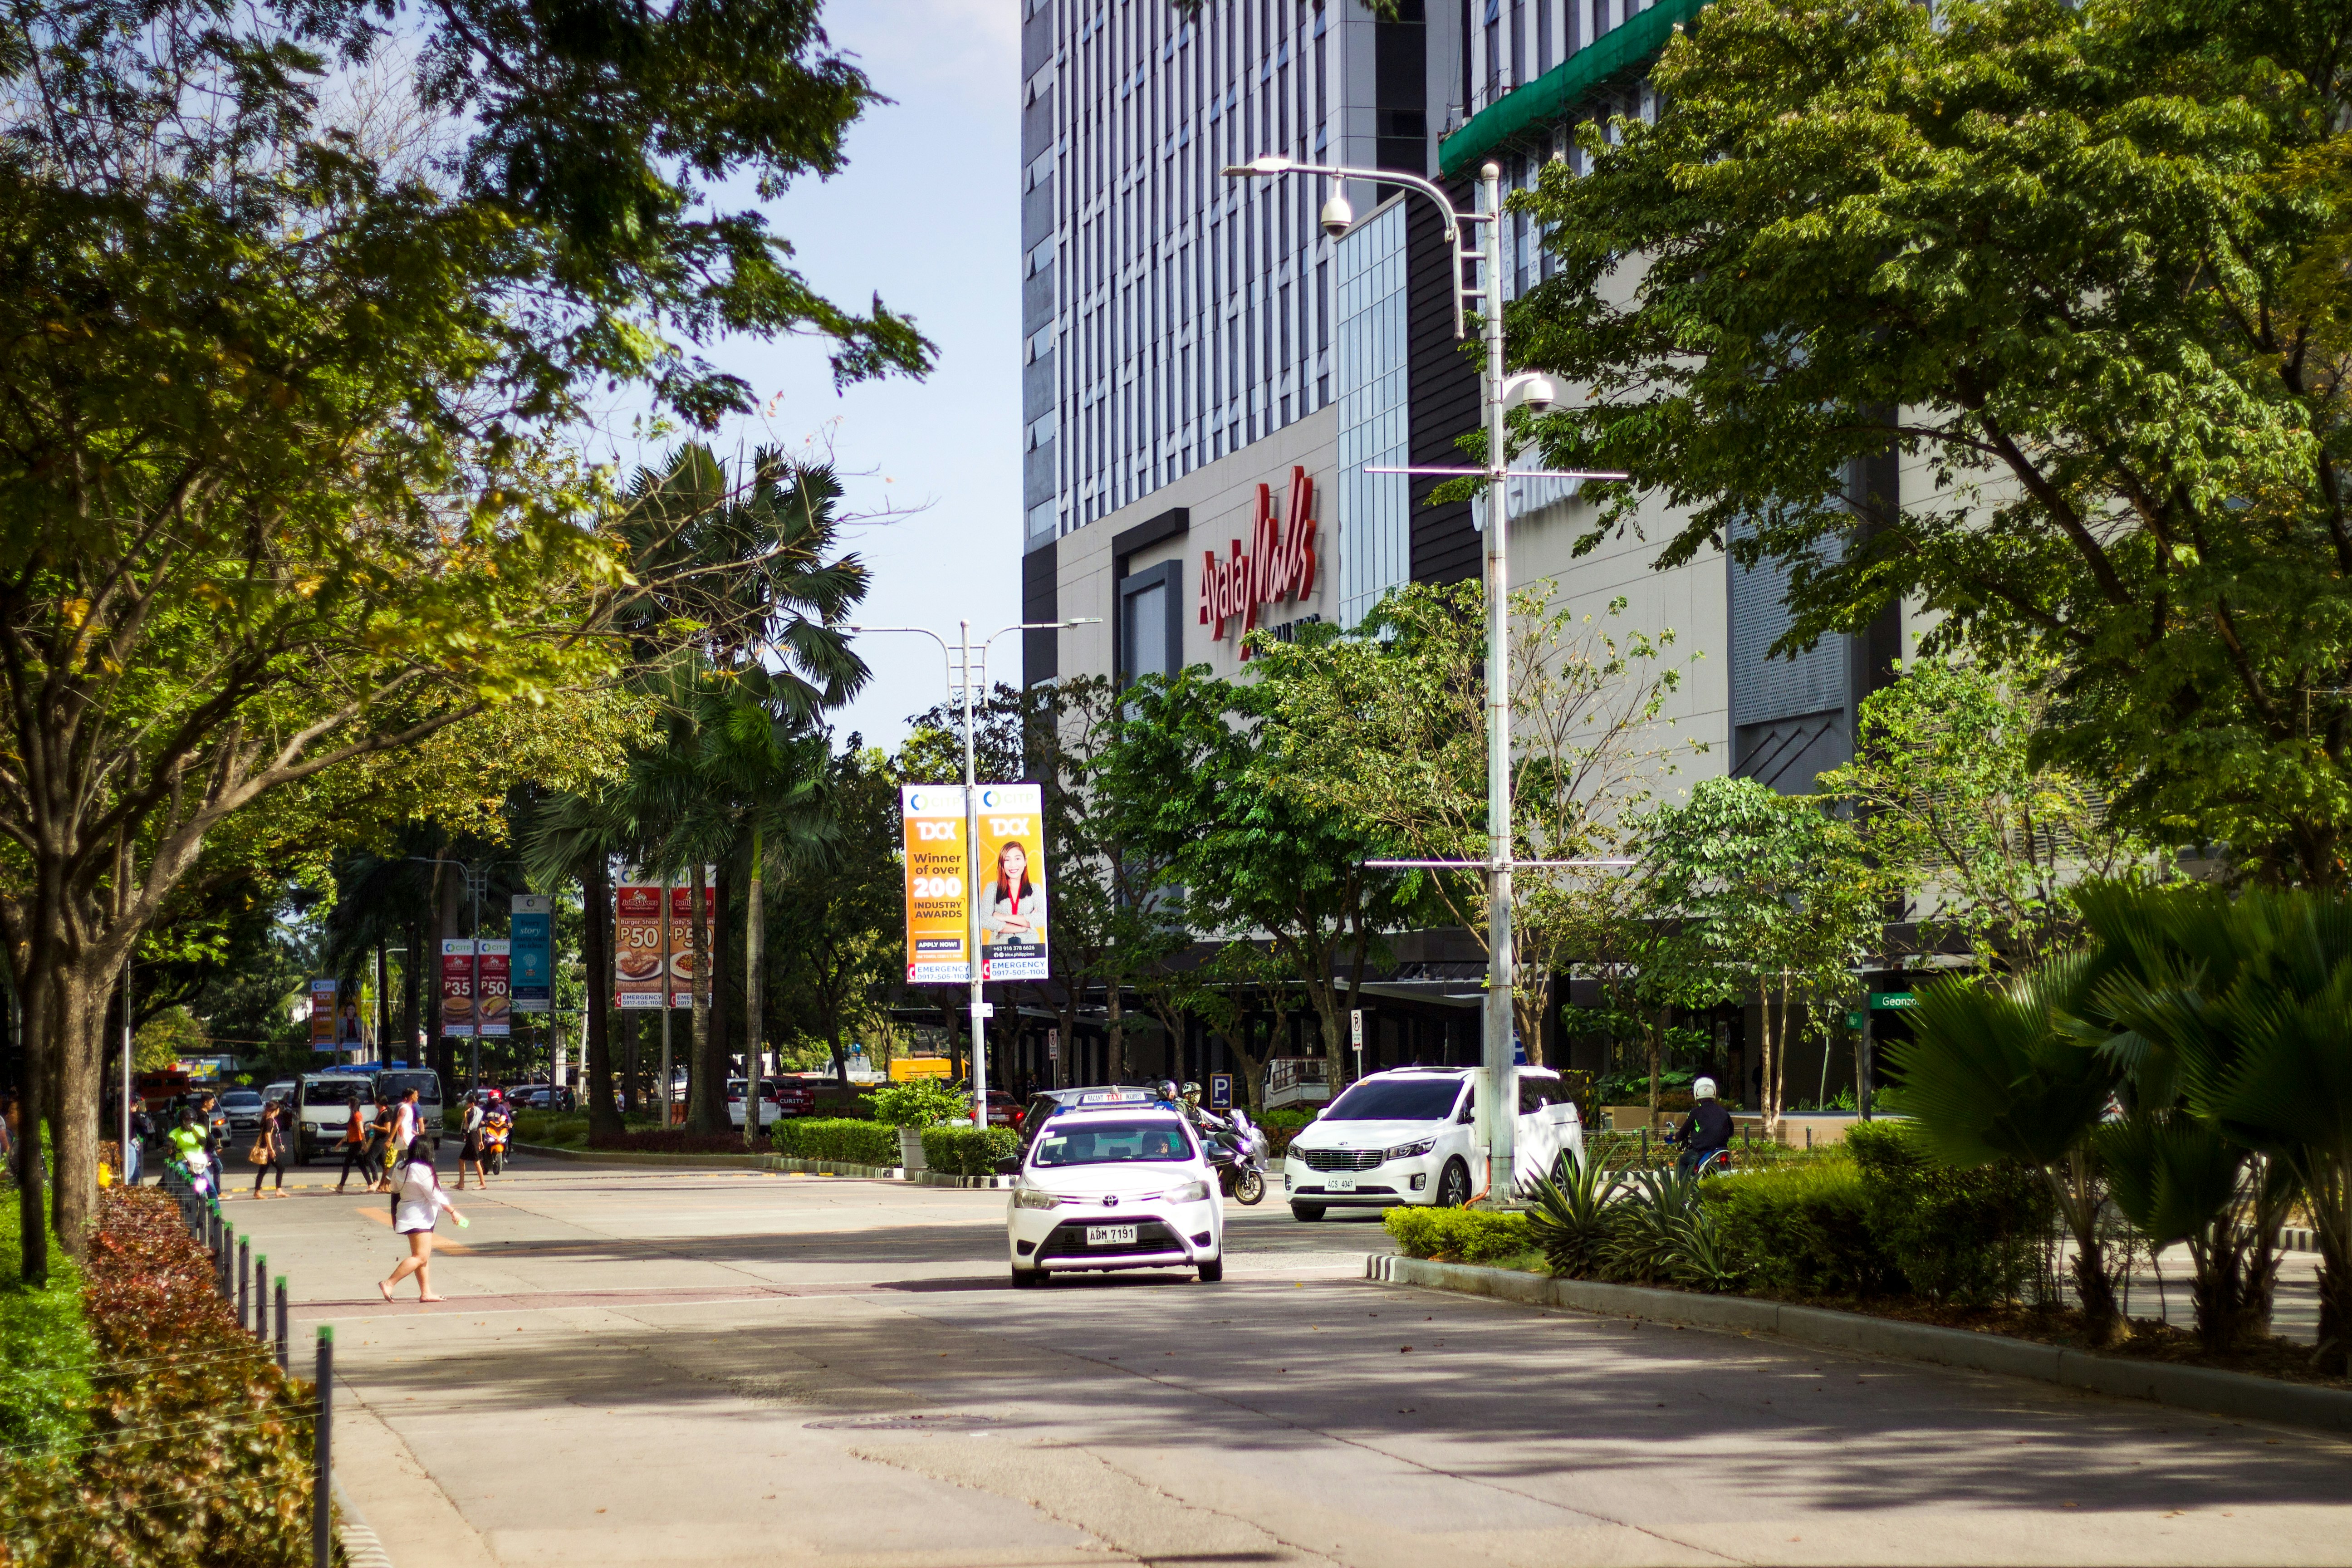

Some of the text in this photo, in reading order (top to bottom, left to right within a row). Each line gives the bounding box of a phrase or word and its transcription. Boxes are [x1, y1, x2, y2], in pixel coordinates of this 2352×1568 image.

[1472, 451, 1576, 531] cema
[1198, 466, 1316, 661] Ayala Malls
[931, 797, 960, 808] CITP
[1004, 793, 1034, 804] CITP
[916, 822, 956, 840] TDCX
[989, 818, 1030, 836] TDCX
[914, 853, 961, 863] Winner
[916, 865, 960, 874] of over
[913, 877, 961, 897] 200
[915, 910, 962, 918] AWARDS
[520, 927, 541, 936] story
[1882, 997, 1920, 1006] Geonzo
[1215, 1079, 1228, 1098] P
[1090, 1229, 1133, 1240] ABM 7191
